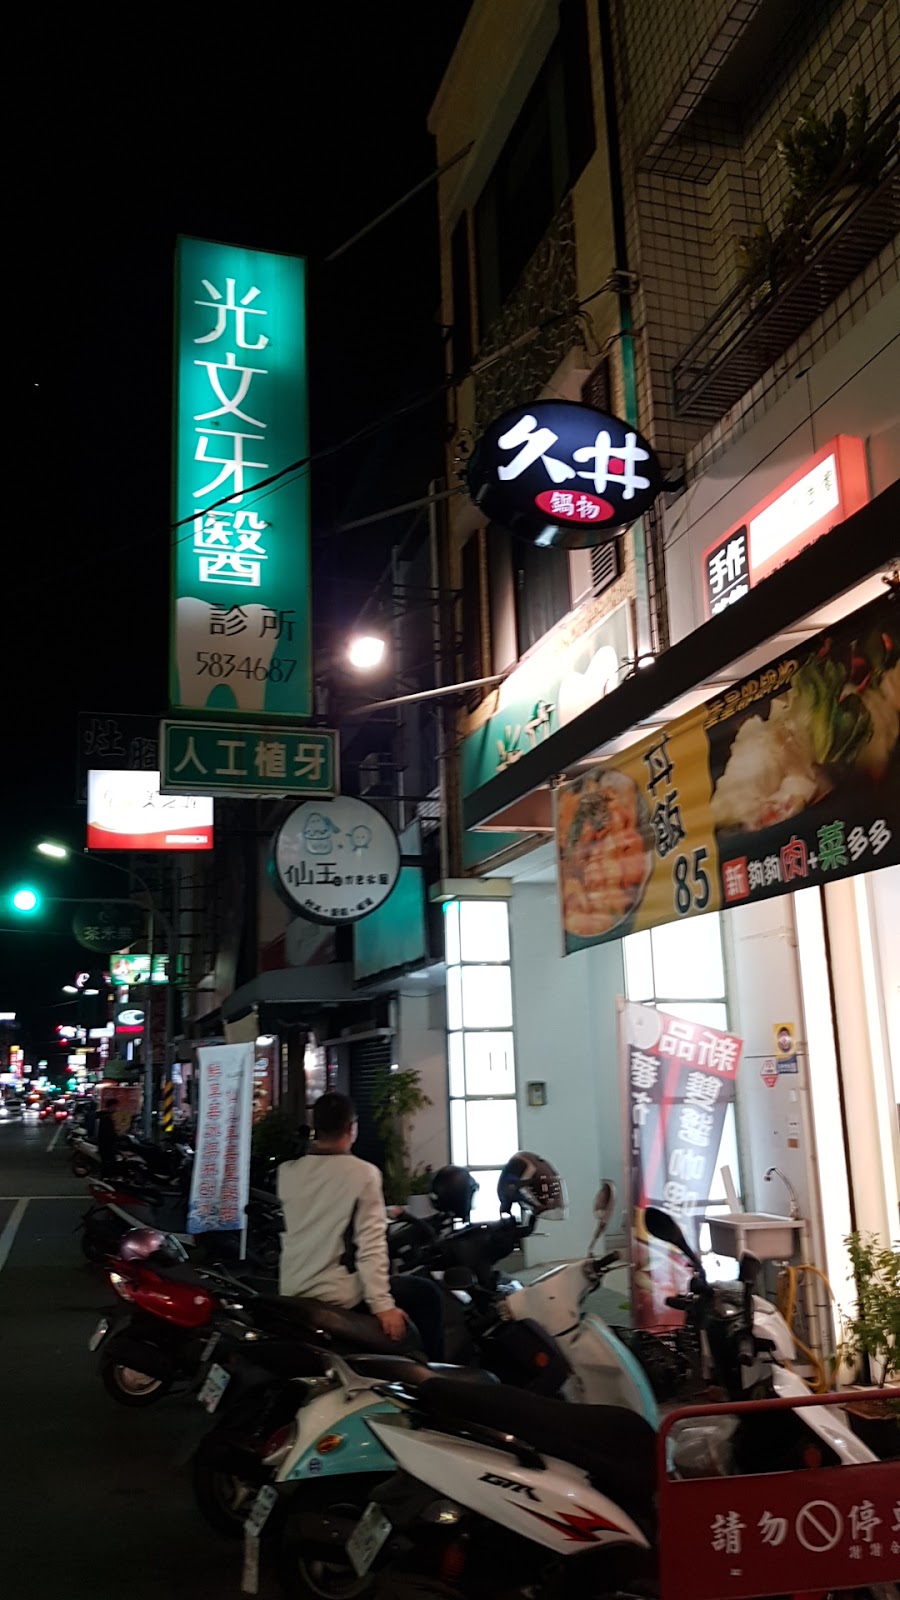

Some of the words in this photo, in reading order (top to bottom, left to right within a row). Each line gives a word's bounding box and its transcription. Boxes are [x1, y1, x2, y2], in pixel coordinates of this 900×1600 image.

[192, 277, 269, 587] 光文牙醫
[498, 415, 650, 500] 久井
[550, 492, 600, 519] 鍋物
[709, 535, 746, 595] 手作
[209, 603, 296, 641] 診所
[196, 651, 297, 683] 5834687
[174, 736, 326, 781] 人工植牙
[674, 847, 711, 914] 85
